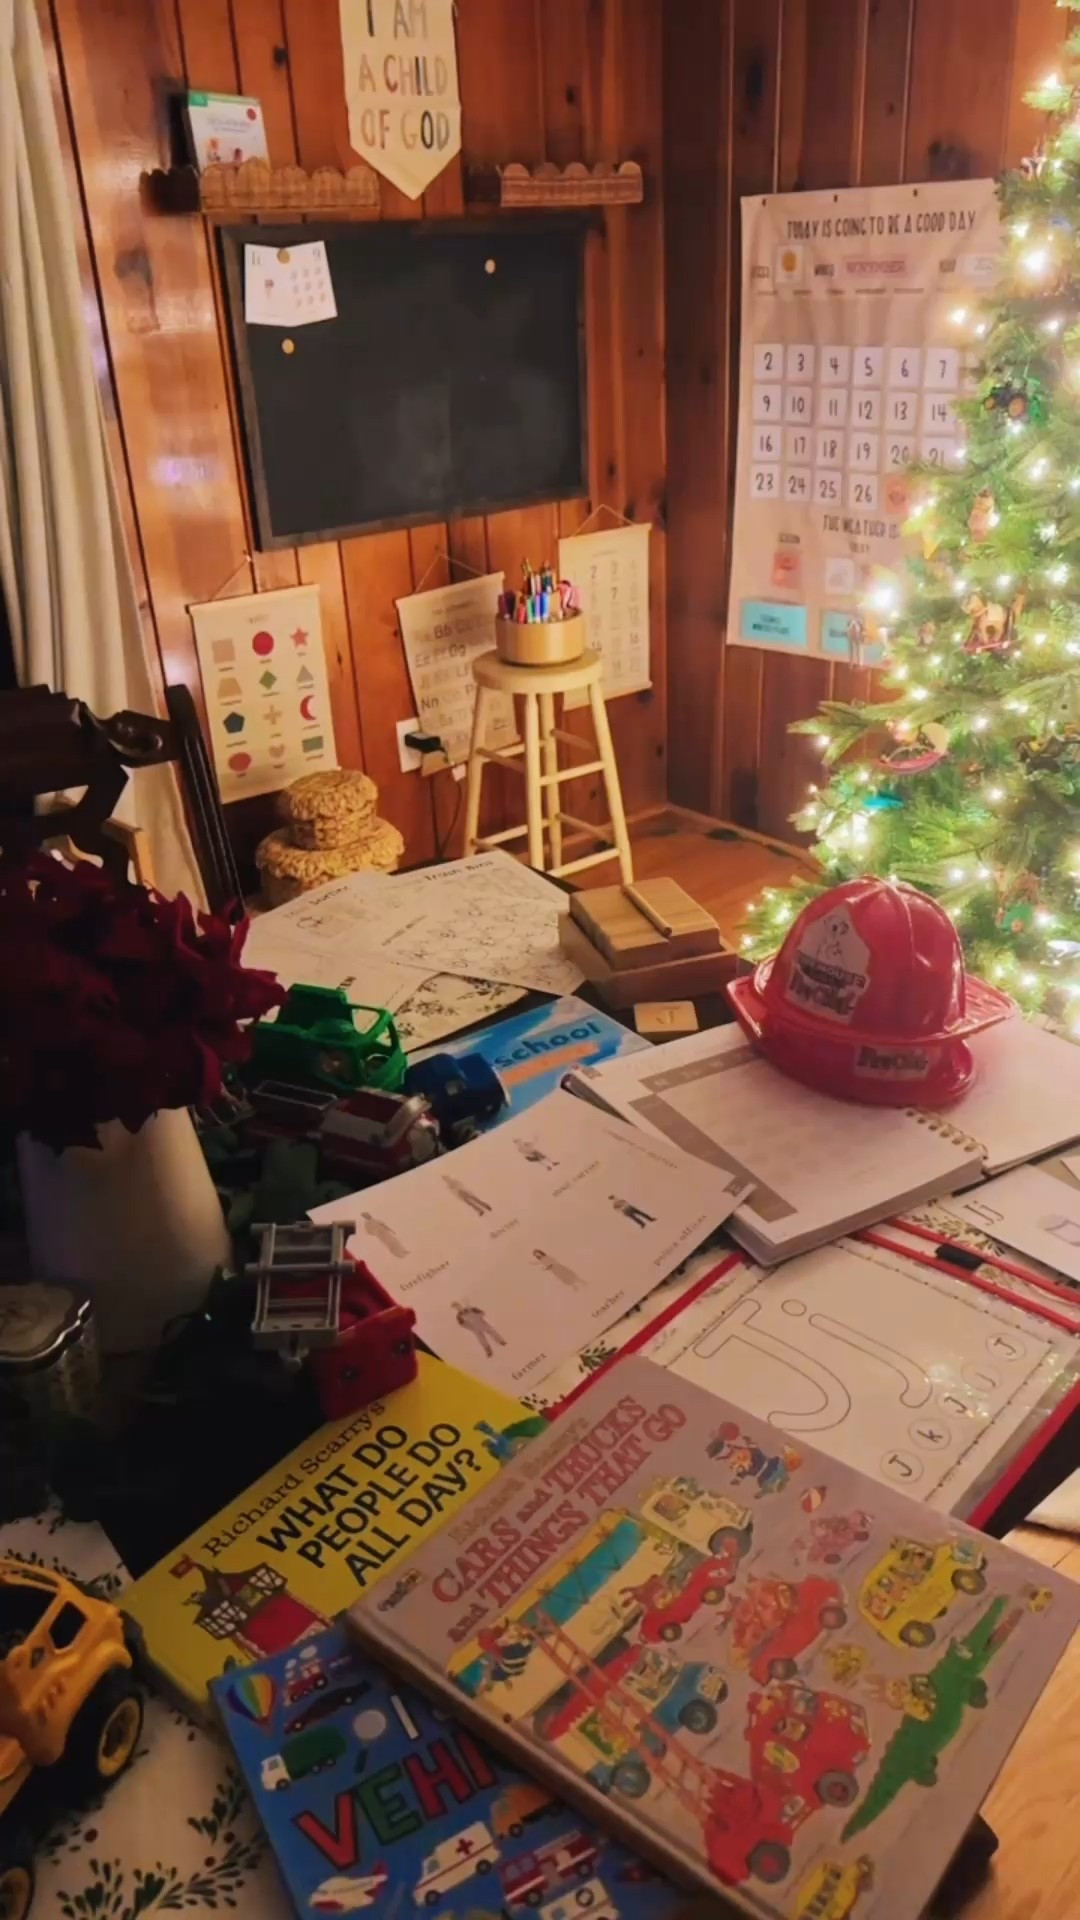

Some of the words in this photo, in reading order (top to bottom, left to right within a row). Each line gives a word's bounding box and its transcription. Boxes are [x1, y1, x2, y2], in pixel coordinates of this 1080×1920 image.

[366, 0, 375, 37] I
[393, 0, 428, 40] AM
[358, 53, 377, 92] A
[383, 54, 448, 97] CHILD
[361, 108, 390, 150] OF
[401, 108, 450, 151] GOD
[787, 218, 819, 240] TODAY
[821, 217, 833, 238] IS
[869, 215, 885, 235] TO
[888, 214, 902, 235] BE
[904, 214, 913, 234] A
[948, 210, 977, 231] DAY
[764, 352, 772, 370] 2
[797, 352, 806, 371] 3
[829, 358, 839, 375] 4
[864, 358, 873, 376] 5
[901, 360, 909, 378] 6
[939, 360, 947, 378] 7
[763, 395, 771, 412] 9
[792, 396, 805, 413] 10
[829, 399, 838, 417] 11
[858, 401, 873, 420] 12
[894, 402, 908, 421] 13
[931, 403, 947, 422] 14
[759, 435, 773, 453] 16
[794, 436, 806, 454] 17
[823, 439, 837, 459] 18
[856, 442, 871, 461] 19
[756, 472, 774, 492] 23
[788, 475, 806, 494] 24
[819, 480, 837, 499] 25
[854, 484, 872, 504] 26
[494, 1021, 602, 1067] school
[511, 1353, 547, 1381] farmer
[202, 1473, 304, 1558] Richard
[300, 1402, 385, 1475] Scarry's
[256, 1464, 359, 1553] WHAT
[352, 1425, 408, 1470] DO
[297, 1462, 419, 1568] PEOPLE
[406, 1423, 461, 1467] DO
[433, 1517, 522, 1603] CARS
[517, 1487, 552, 1524] and
[541, 1396, 646, 1493] TRUCKS
[344, 1526, 411, 1587] ALL
[397, 1448, 482, 1527] DAY?
[448, 1603, 490, 1643] and
[476, 1500, 590, 1608] THINGS
[577, 1434, 651, 1507] THAT
[642, 1404, 687, 1442] GO
[291, 1730, 498, 1870] VEHI
